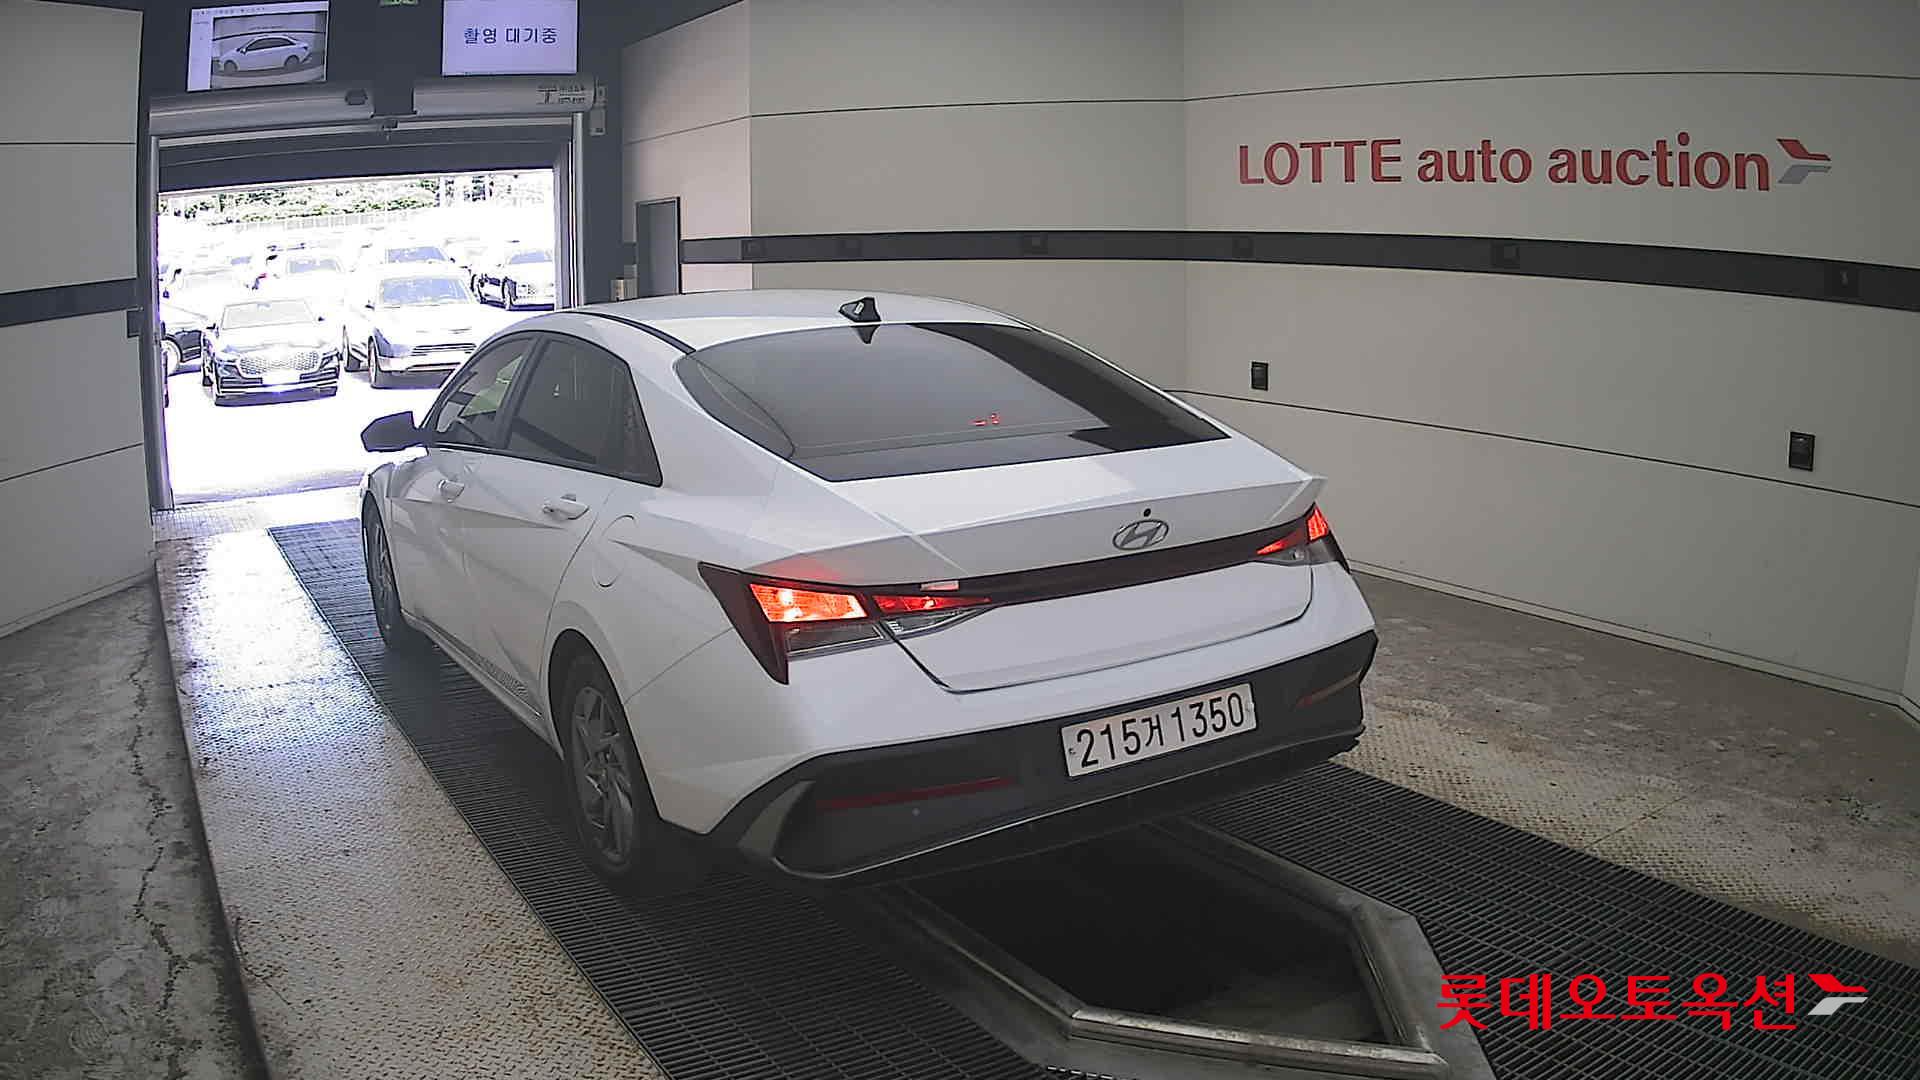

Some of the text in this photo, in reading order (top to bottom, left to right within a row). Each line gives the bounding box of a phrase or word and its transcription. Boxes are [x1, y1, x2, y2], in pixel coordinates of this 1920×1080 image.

[463, 27, 558, 44] 촬영 대기중
[1239, 131, 1770, 191] LOTTE auto auction
[1077, 692, 1244, 768] 215거 1350
